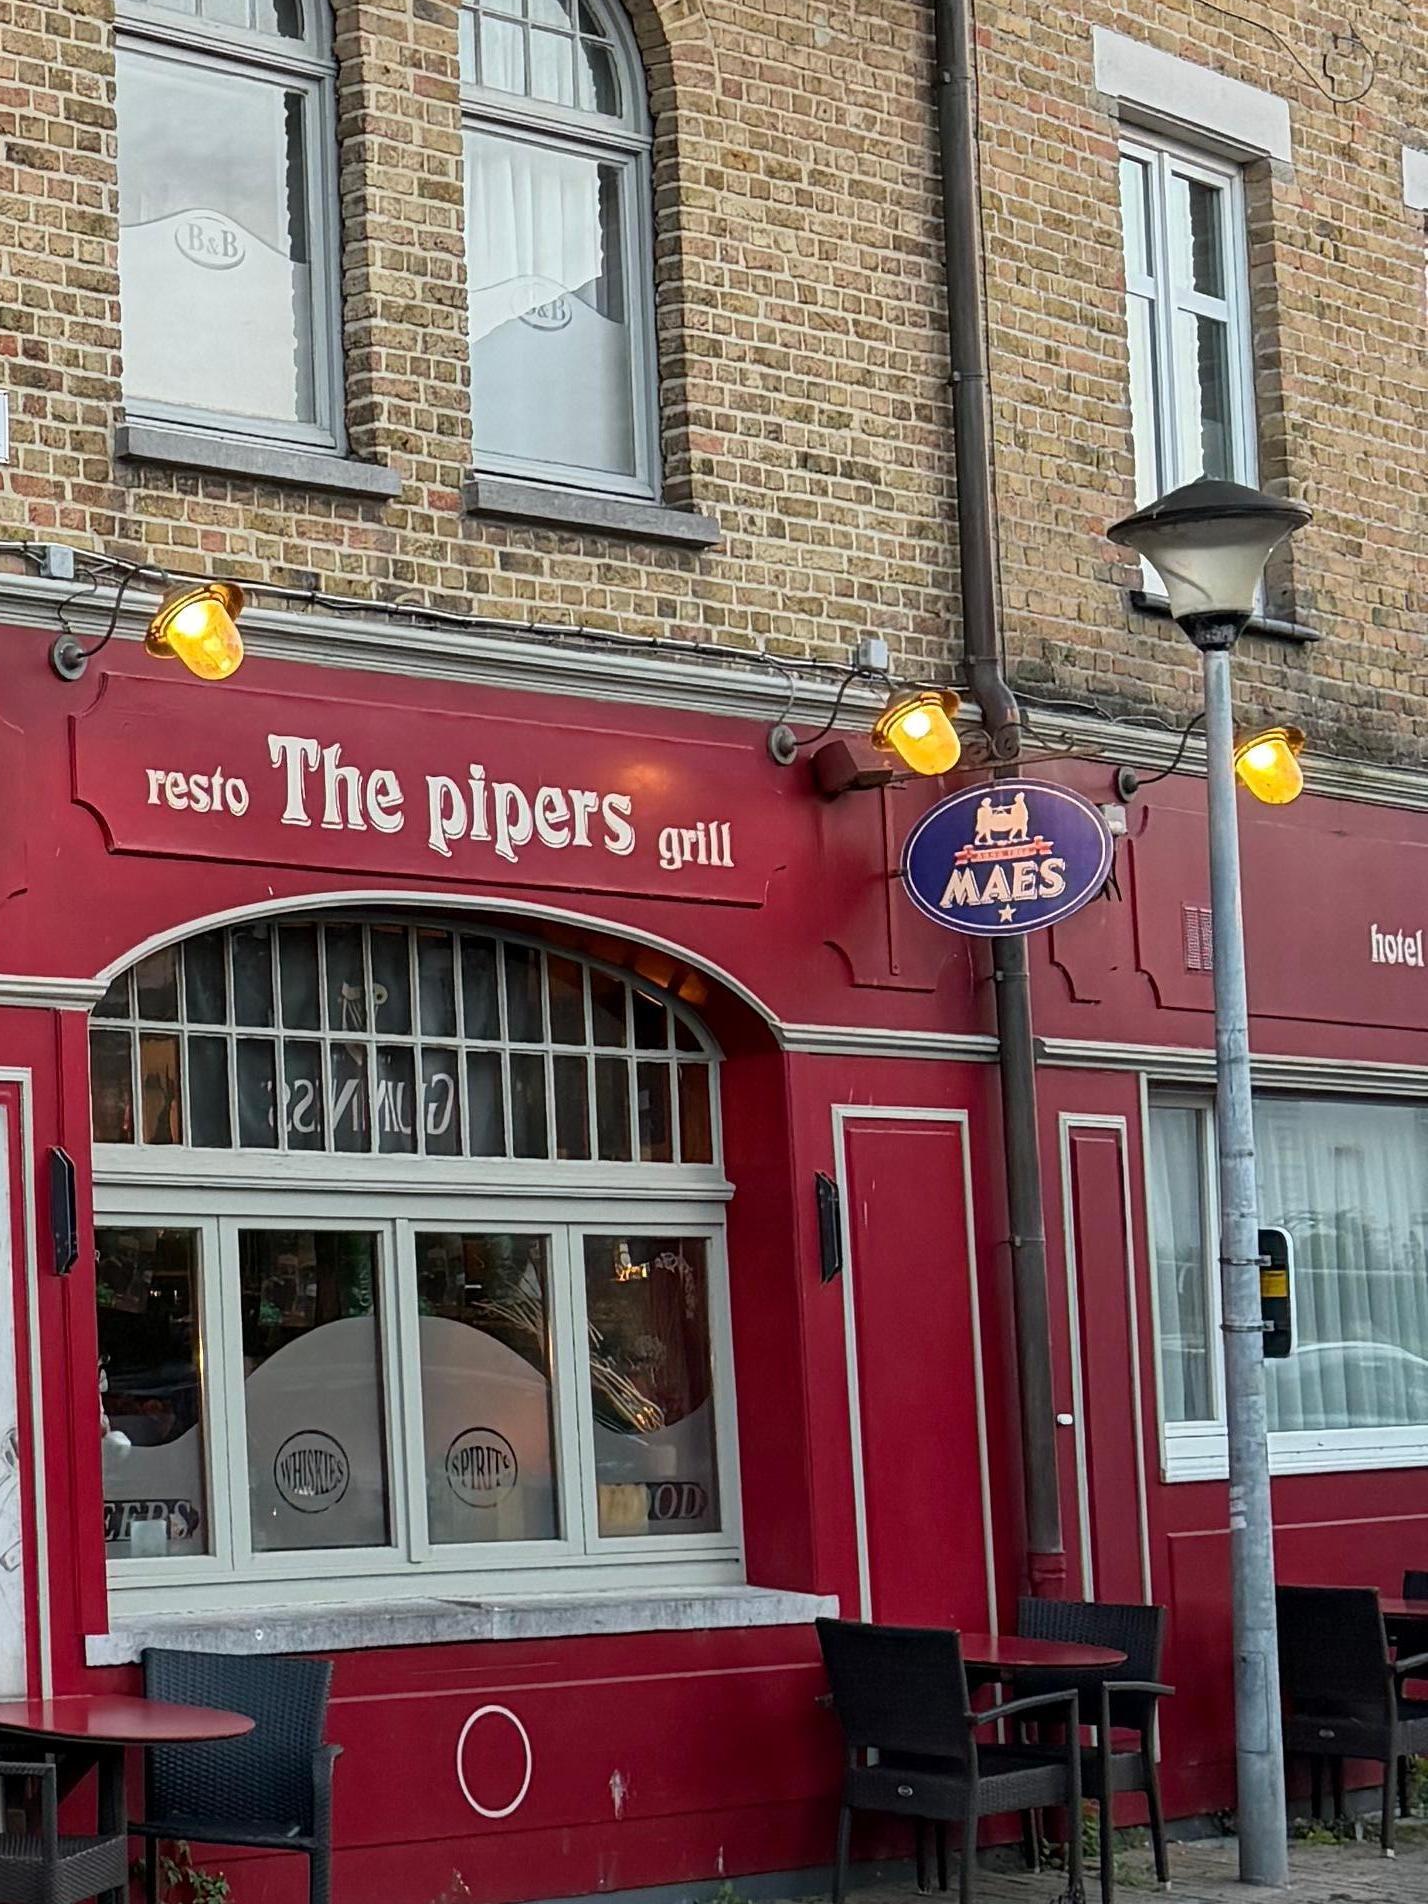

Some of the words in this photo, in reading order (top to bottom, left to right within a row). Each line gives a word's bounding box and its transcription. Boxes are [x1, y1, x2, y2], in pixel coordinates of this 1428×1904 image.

[187, 223, 238, 257] B&B
[146, 766, 248, 816] resto
[267, 734, 404, 833] The
[425, 763, 636, 863] pipers
[658, 821, 735, 870] grill
[939, 857, 1067, 909] MAES
[1370, 923, 1425, 967] hotel
[280, 1449, 344, 1495] WHISKIES
